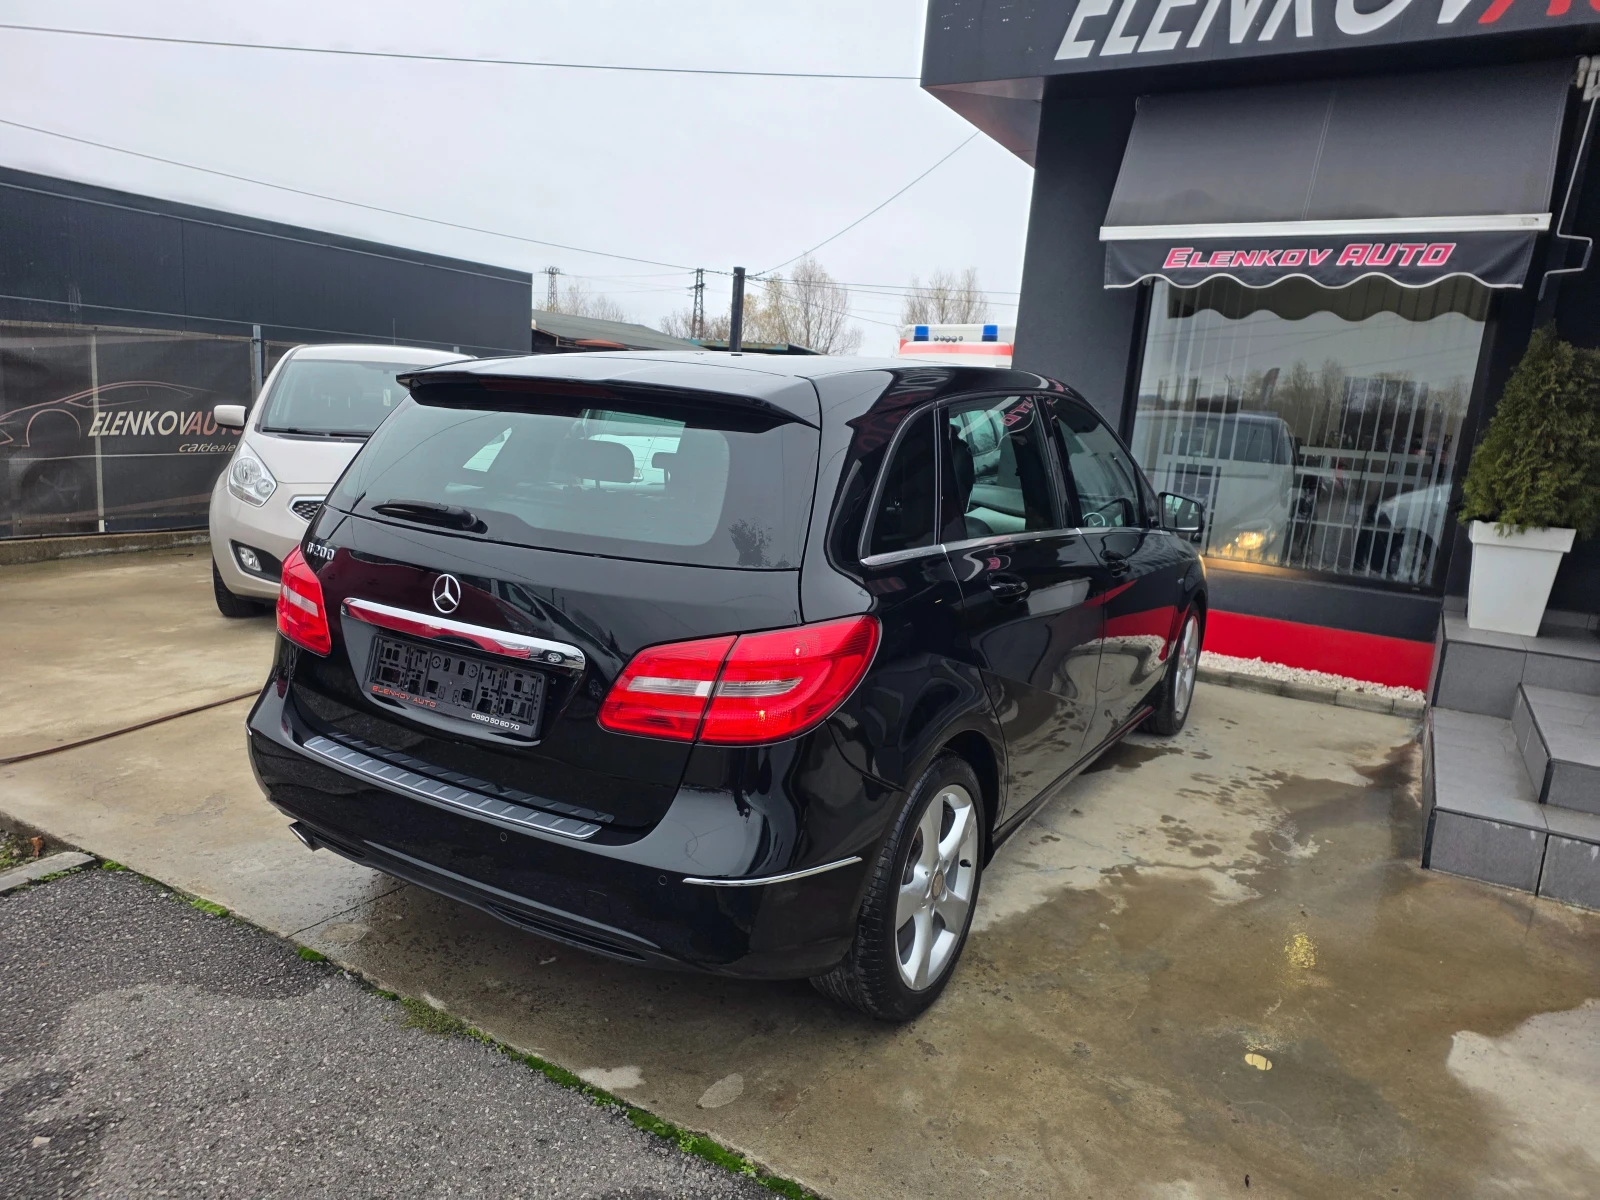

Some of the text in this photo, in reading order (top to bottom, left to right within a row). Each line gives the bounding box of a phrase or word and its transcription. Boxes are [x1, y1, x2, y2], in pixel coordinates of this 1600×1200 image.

[1162, 242, 1457, 269] ELENKOV AUTO
[88, 410, 243, 437] ELENKOVAU
[178, 442, 237, 453] cardeale
[412, 696, 437, 708] AUTO
[510, 723, 520, 731] 70
